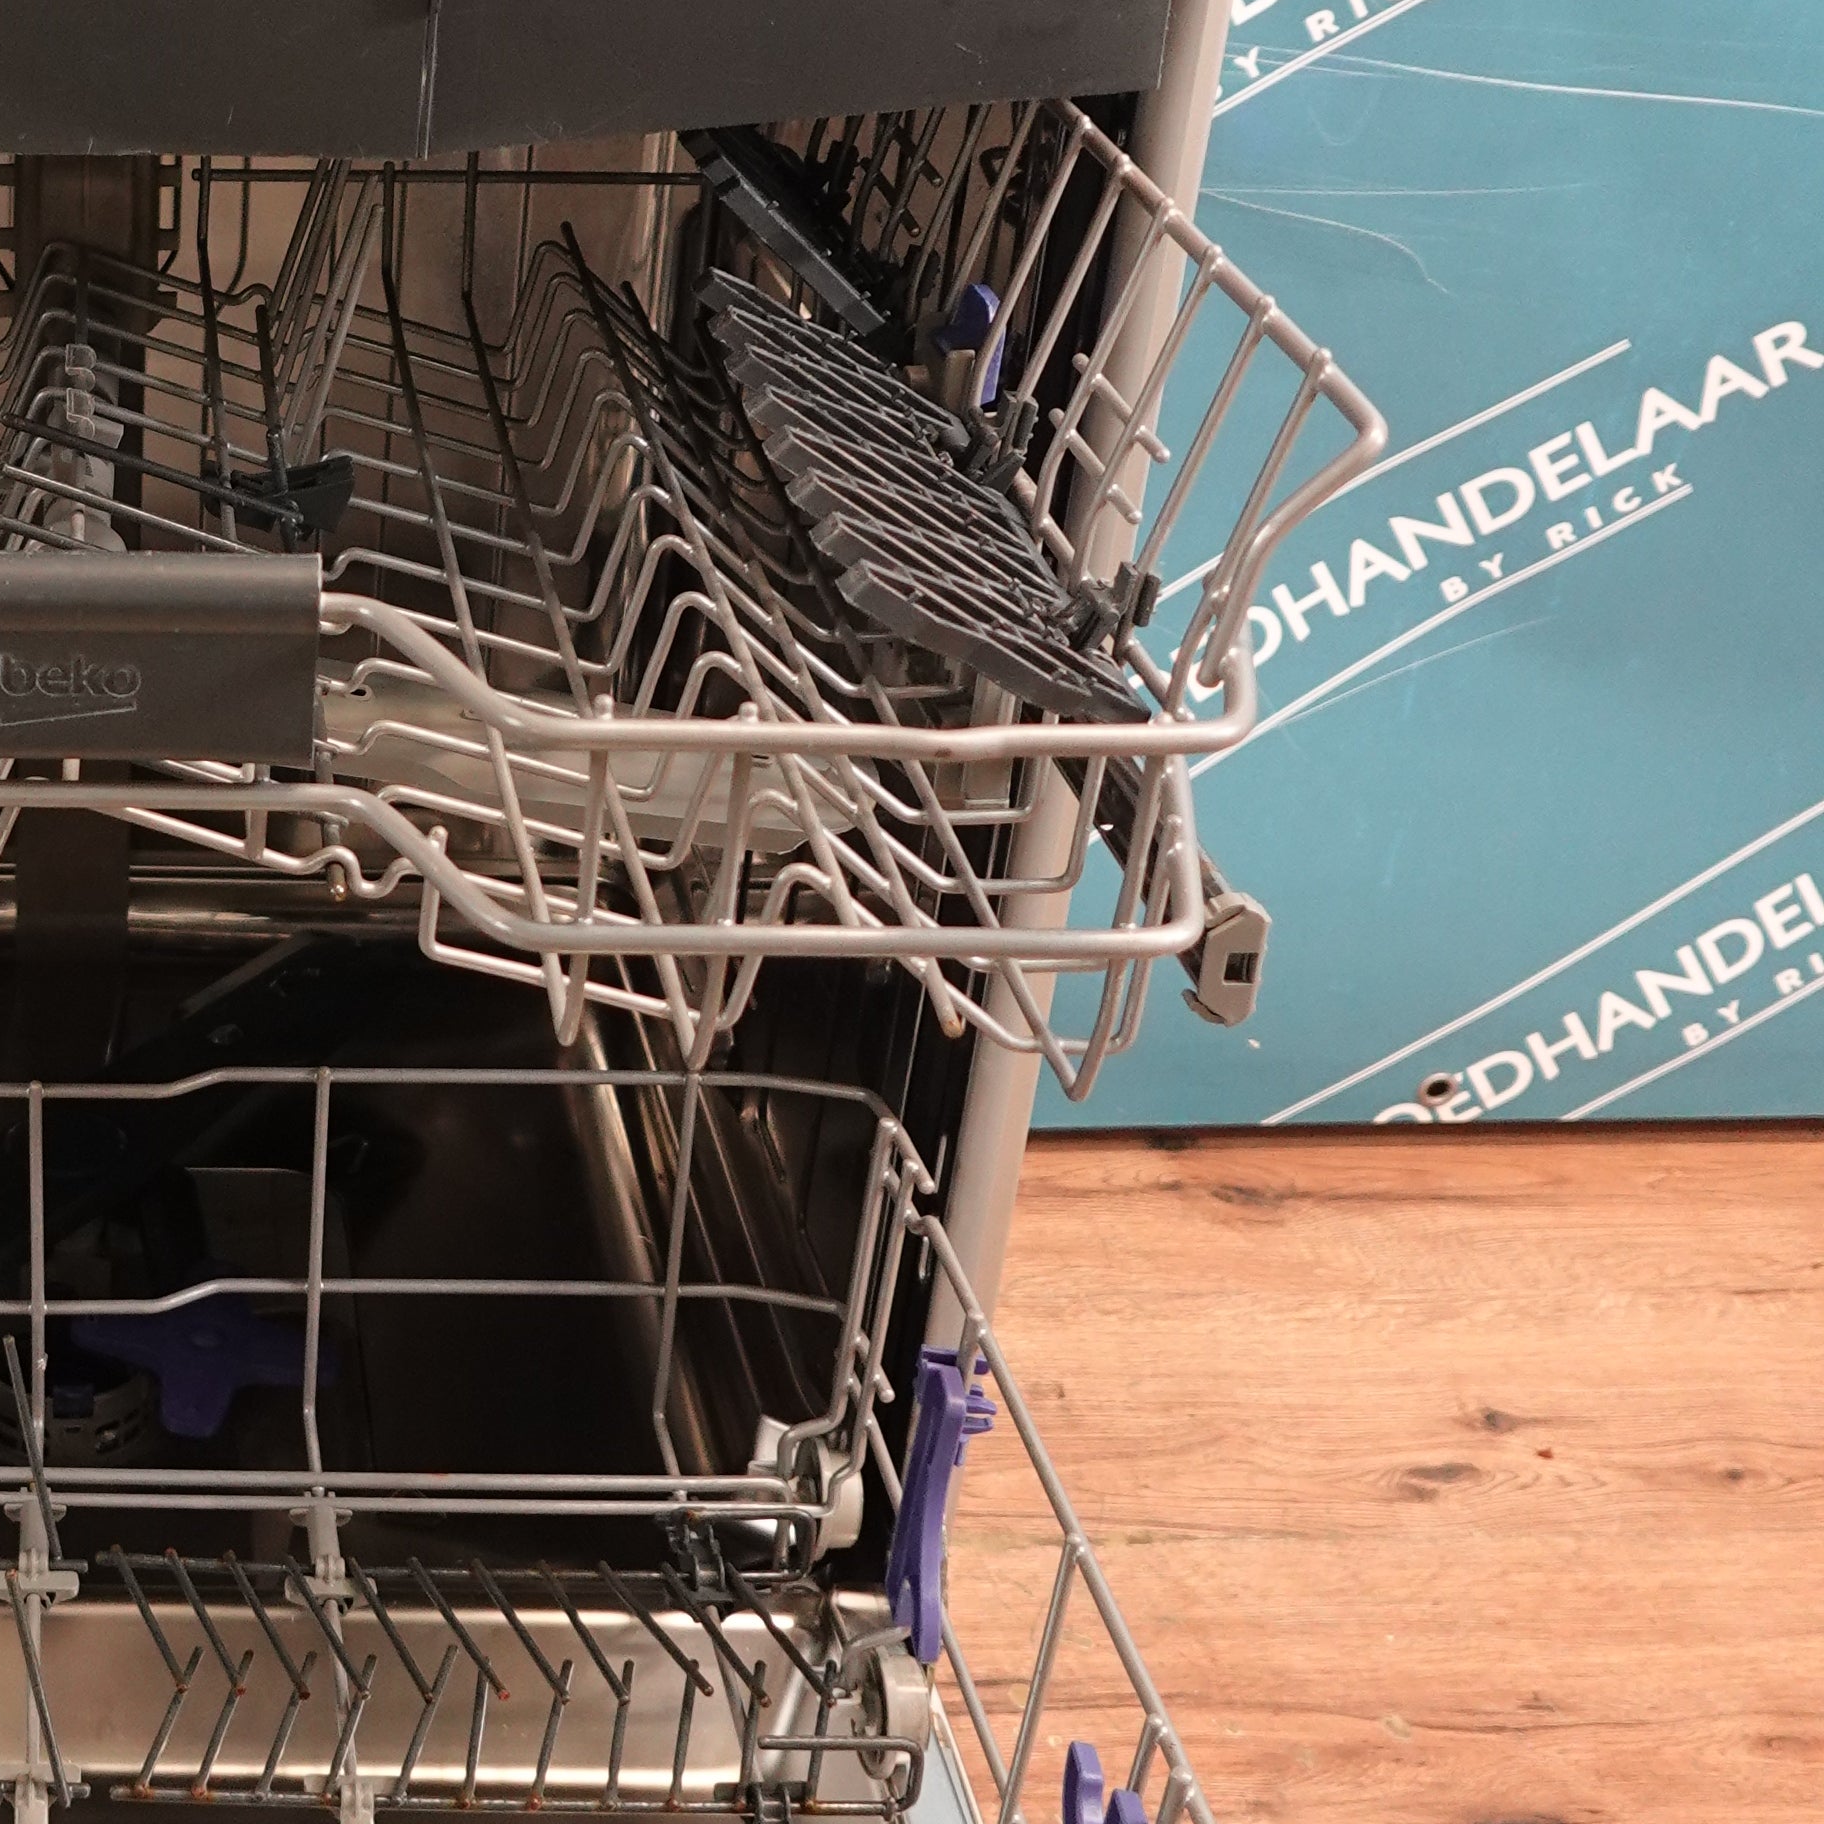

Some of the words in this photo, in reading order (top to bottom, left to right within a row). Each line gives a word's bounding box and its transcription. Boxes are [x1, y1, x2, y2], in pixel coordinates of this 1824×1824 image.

[1439, 554, 1506, 603] BY
[1546, 464, 1684, 550] RICK
[1682, 1000, 1740, 1047] BY
